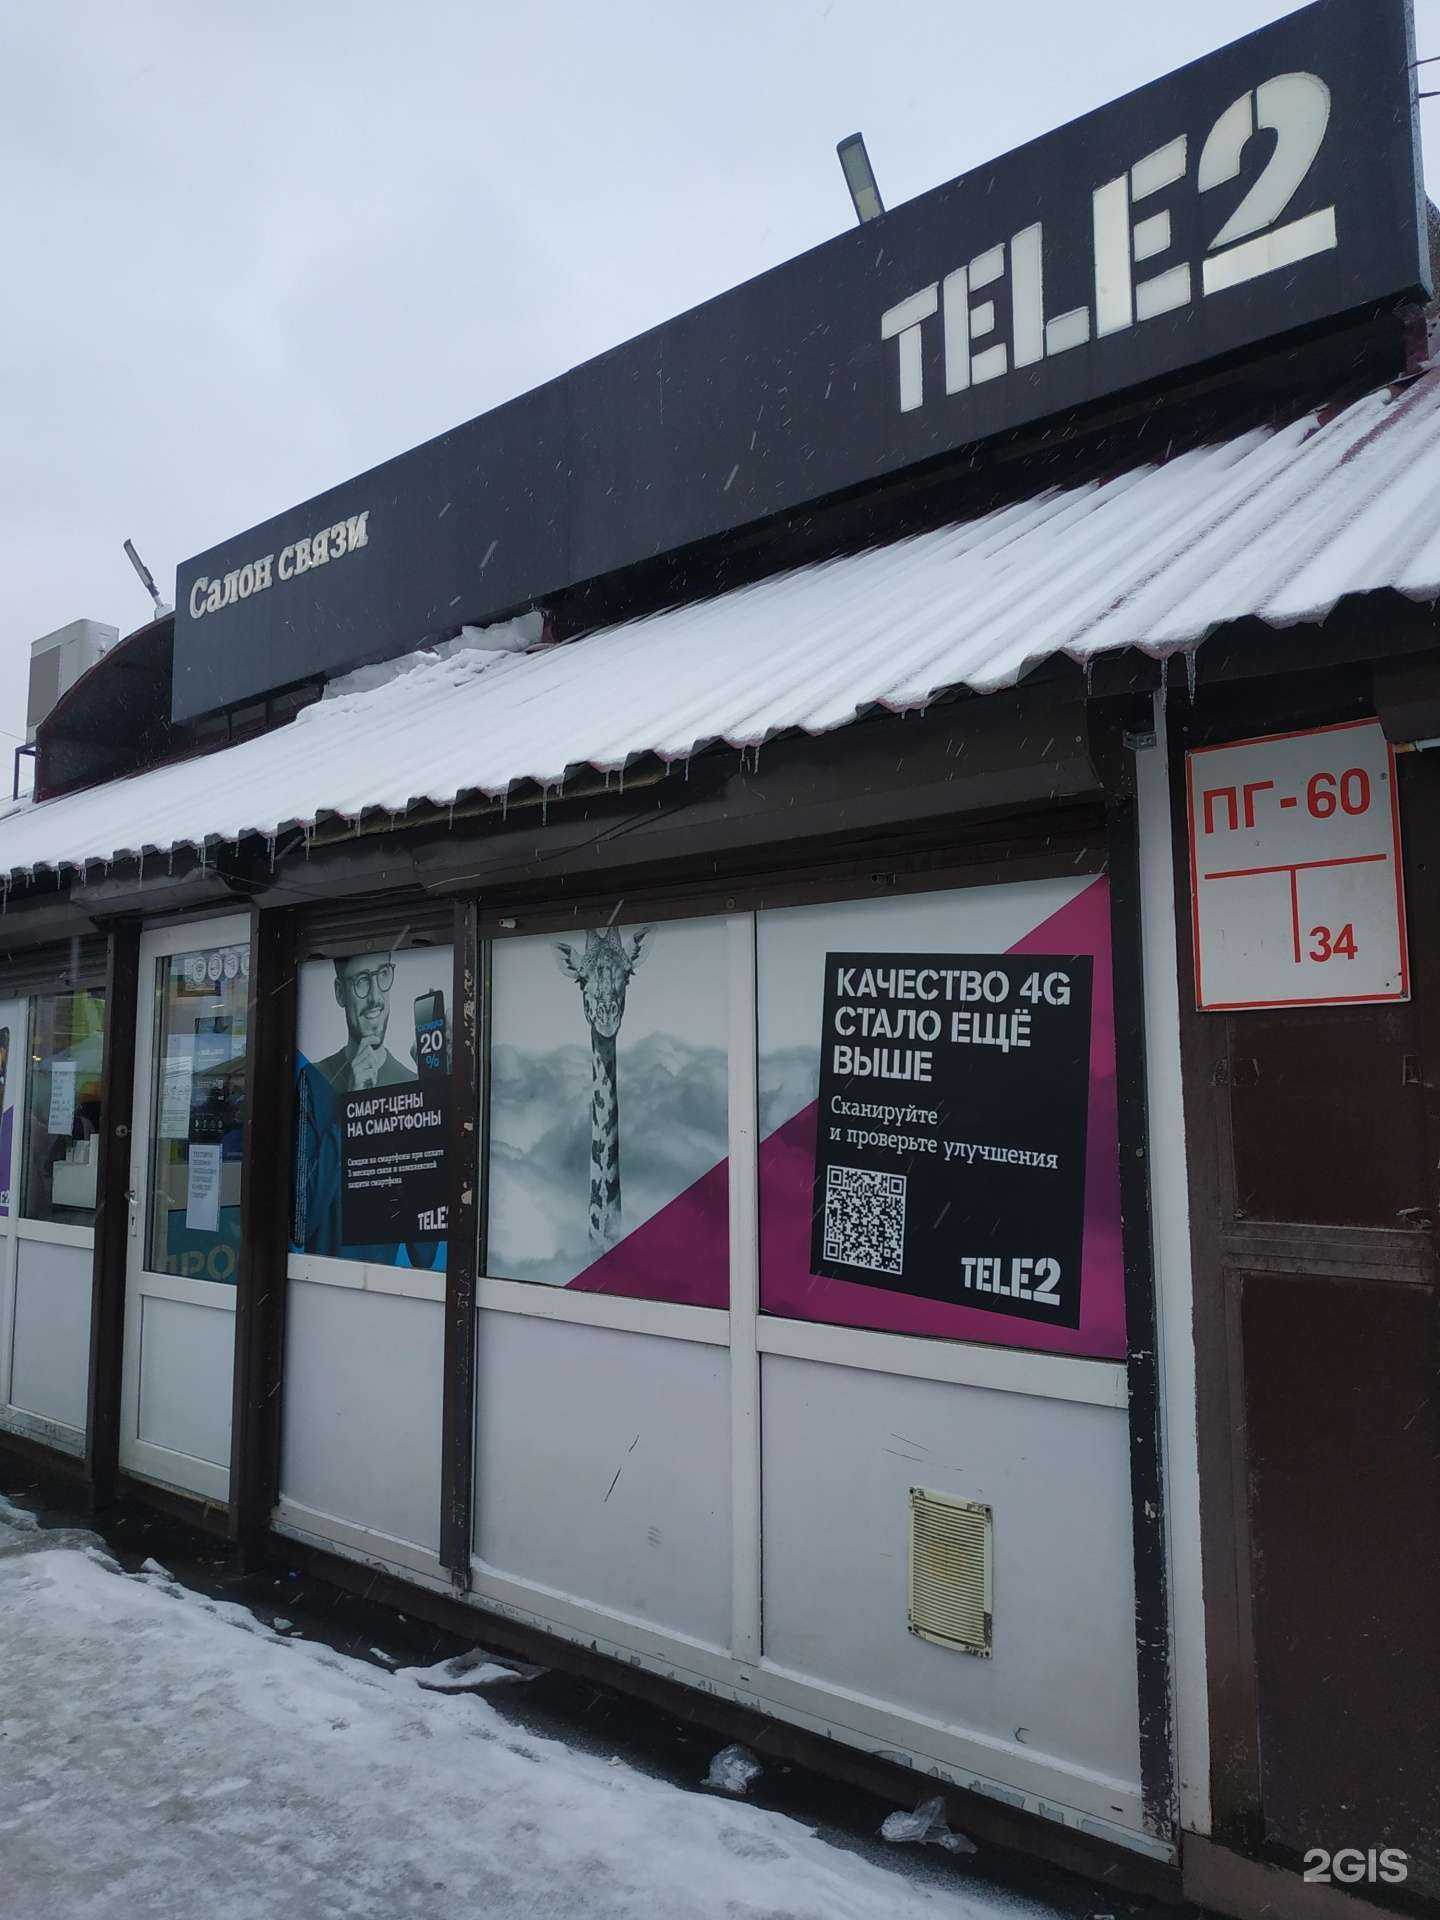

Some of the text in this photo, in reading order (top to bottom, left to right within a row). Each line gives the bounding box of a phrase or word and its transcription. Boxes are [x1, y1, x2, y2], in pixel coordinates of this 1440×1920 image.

[881, 71, 1337, 415] TELE2
[189, 510, 370, 619] Салон связи
[1203, 767, 1370, 834] ПГ-60
[1309, 923, 1358, 962] 34
[836, 967, 1071, 1006] КАЧЕСТВО 4G
[420, 1030, 443, 1054] 20
[834, 1005, 1032, 1053] СТАЛО ЕЩЁ
[833, 1045, 933, 1082] ВЫШЕ
[346, 1092, 424, 1118] СМАРТ-ЦЕНЫ
[347, 1110, 442, 1138] НА СМАРТФОНЫ
[831, 1095, 938, 1129] Сканируйте
[829, 1127, 1060, 1170] и проверьте улучшения
[417, 1206, 449, 1231] TELE
[960, 1256, 1062, 1306] TELE2
